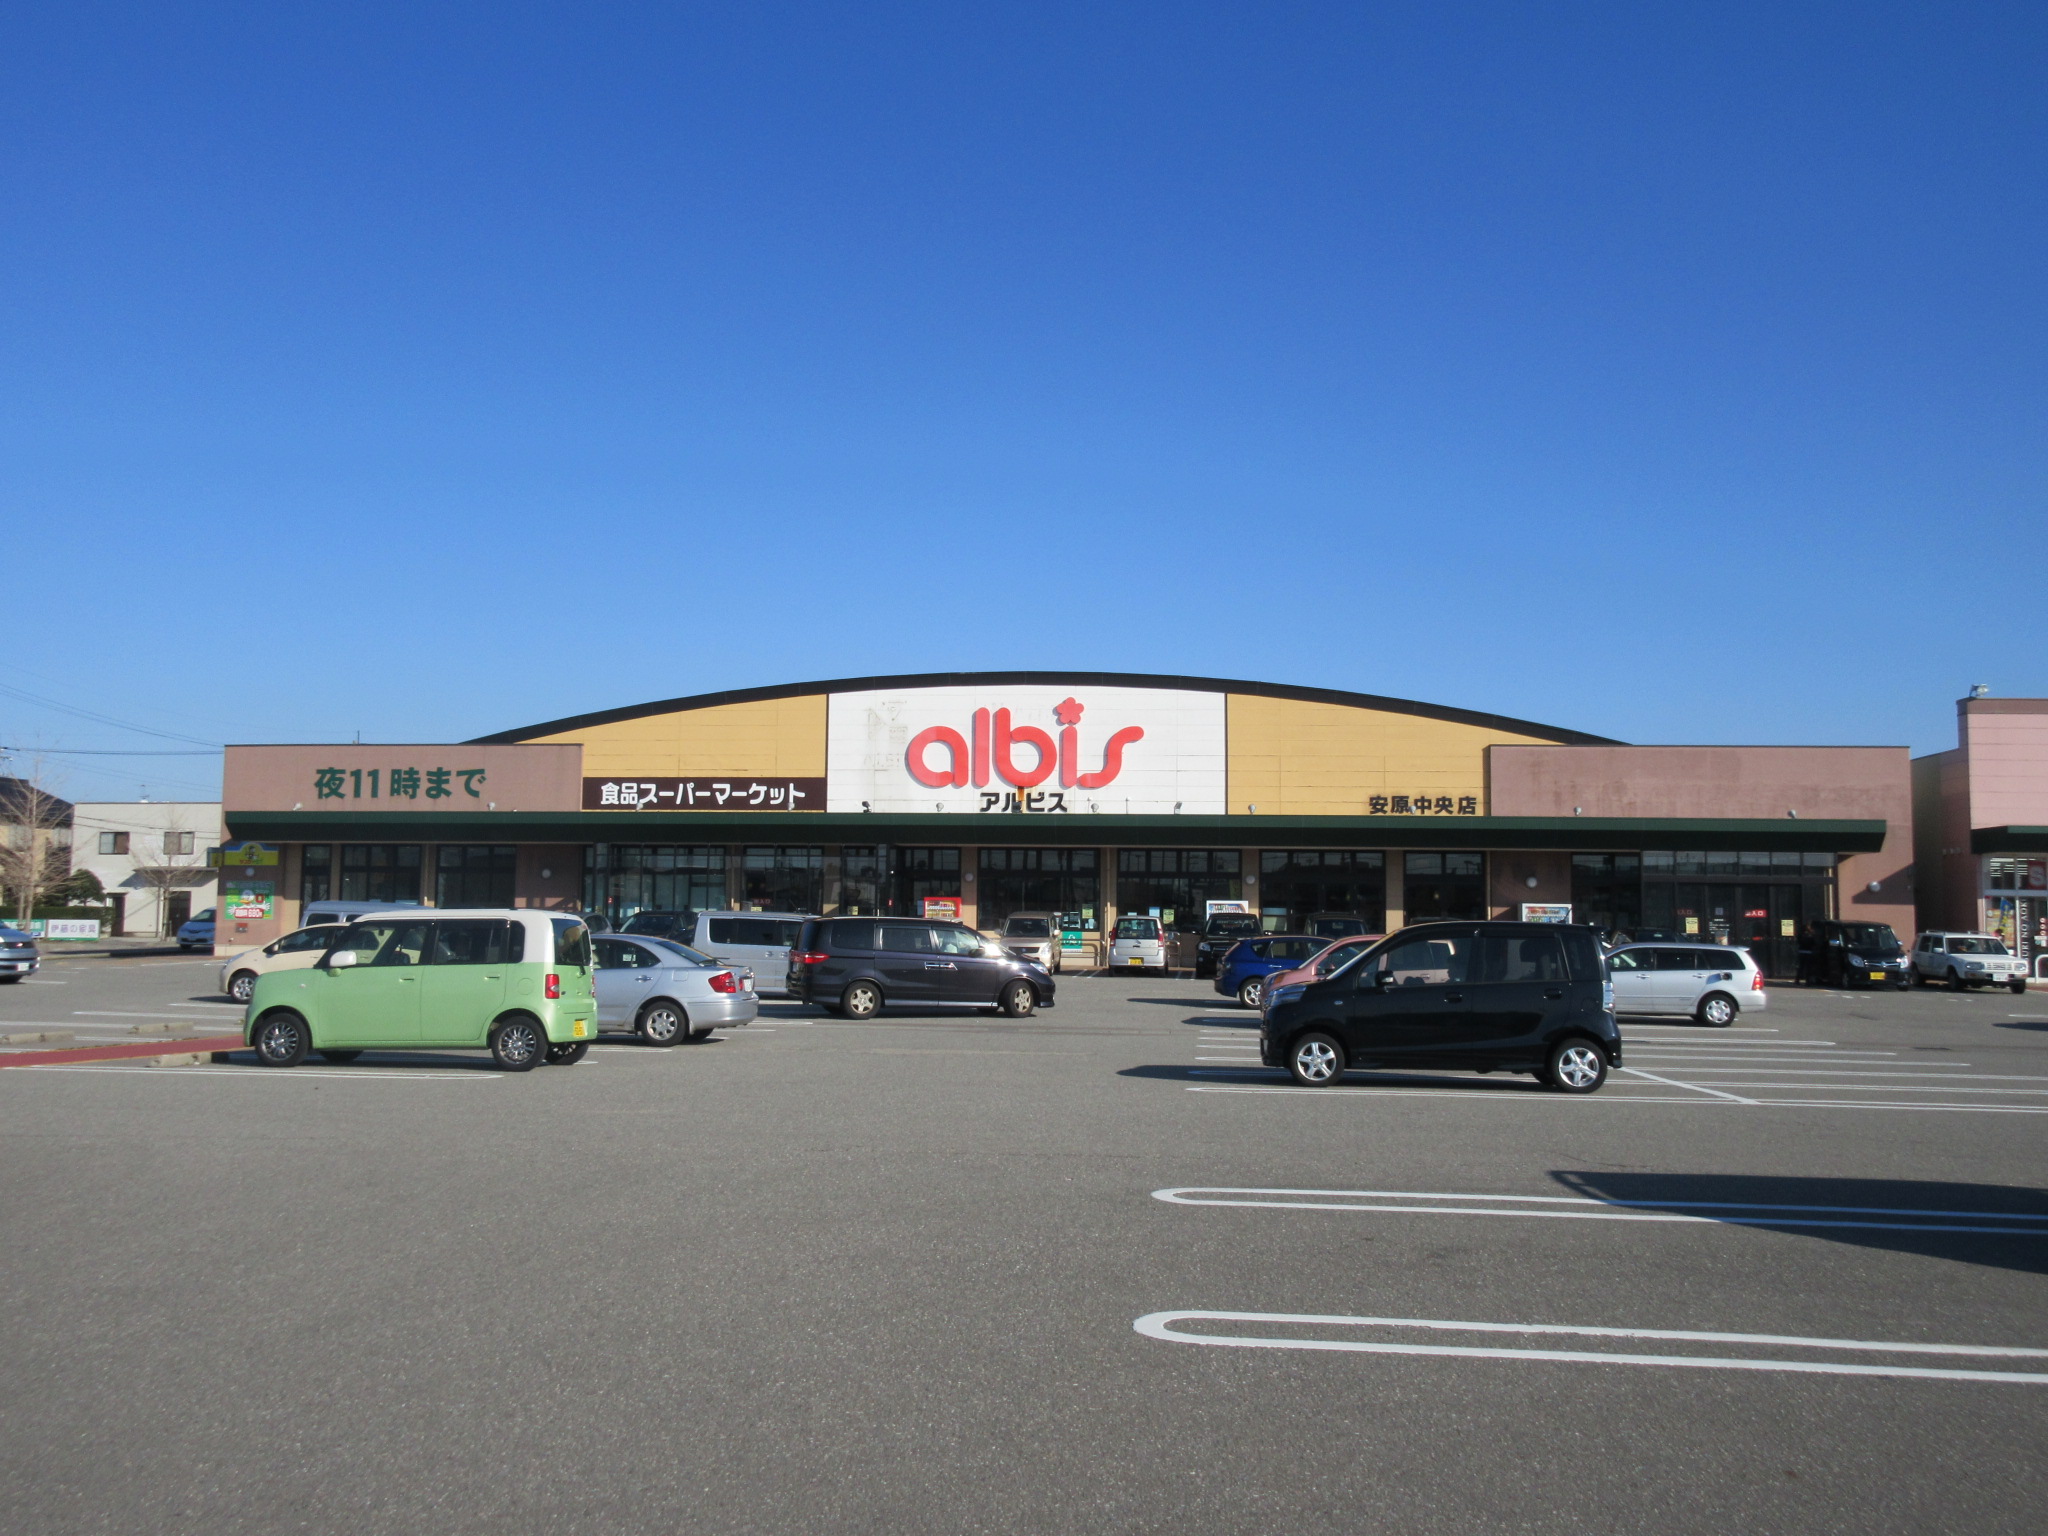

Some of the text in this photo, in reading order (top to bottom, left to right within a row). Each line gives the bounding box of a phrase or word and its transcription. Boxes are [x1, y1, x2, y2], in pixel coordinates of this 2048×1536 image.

[904, 697, 1145, 789] albis
[314, 767, 487, 800] 夜11時まで
[600, 782, 806, 805] 食品スーパーマーケット
[979, 792, 1068, 812] アルビス
[1368, 795, 1477, 815] 安原中央店
[2021, 941, 2029, 960] URI
